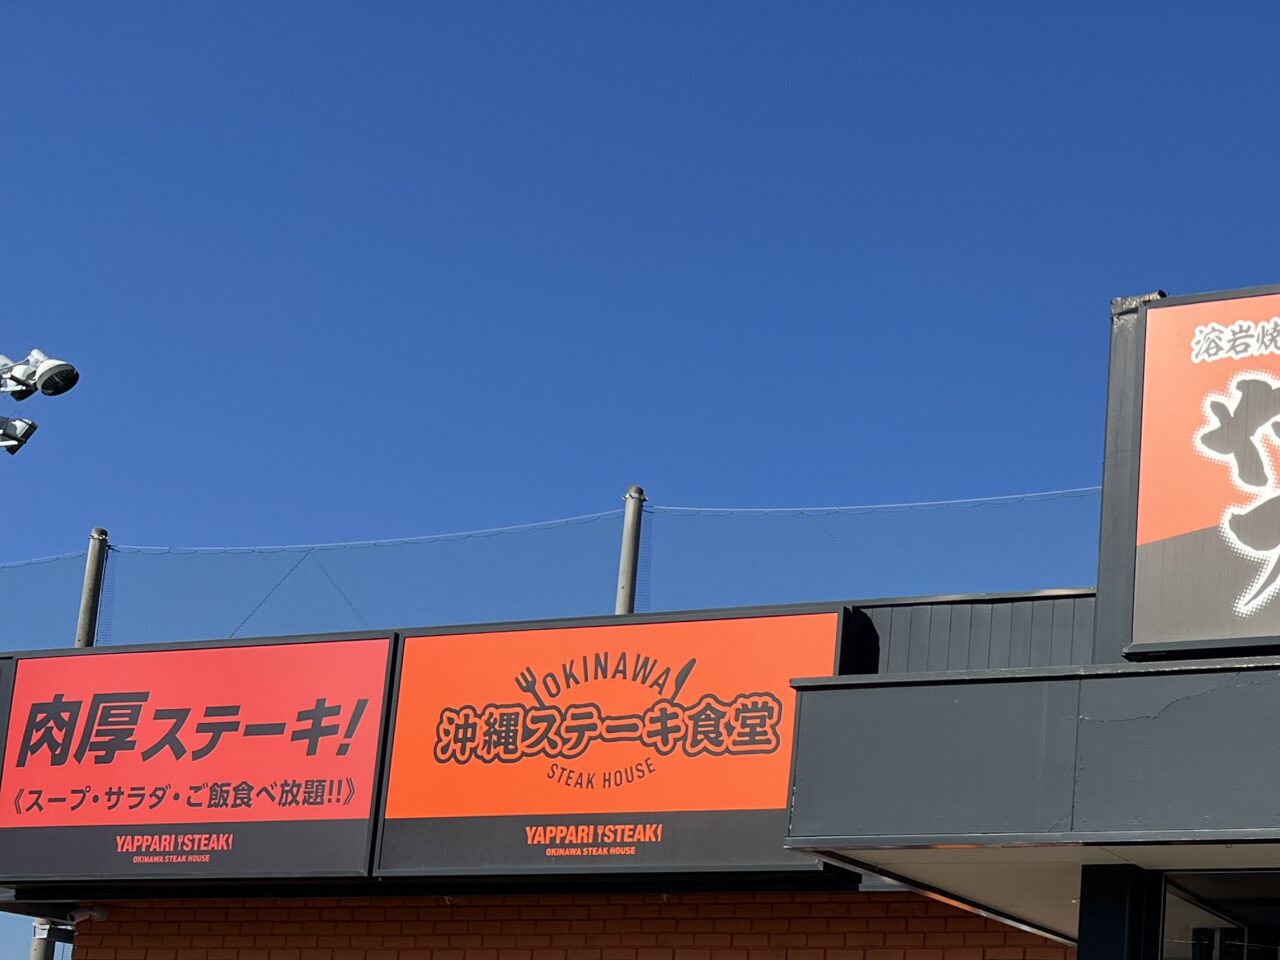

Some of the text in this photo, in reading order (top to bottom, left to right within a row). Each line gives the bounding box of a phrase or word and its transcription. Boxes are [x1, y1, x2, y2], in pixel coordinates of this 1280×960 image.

[542, 651, 672, 698] OKINAWA
[15, 690, 370, 768] 肉厚ステーキ!
[433, 691, 783, 766] 沖縄ステーキ食堂
[546, 756, 656, 790] STEAK HOUSE
[116, 834, 175, 853] YAPPARI
[525, 826, 594, 845] YAPPARI
[132, 854, 211, 864] OKINAWA STEAK HOUSE
[545, 846, 636, 857] OKINAWA STEAK HOUSE
